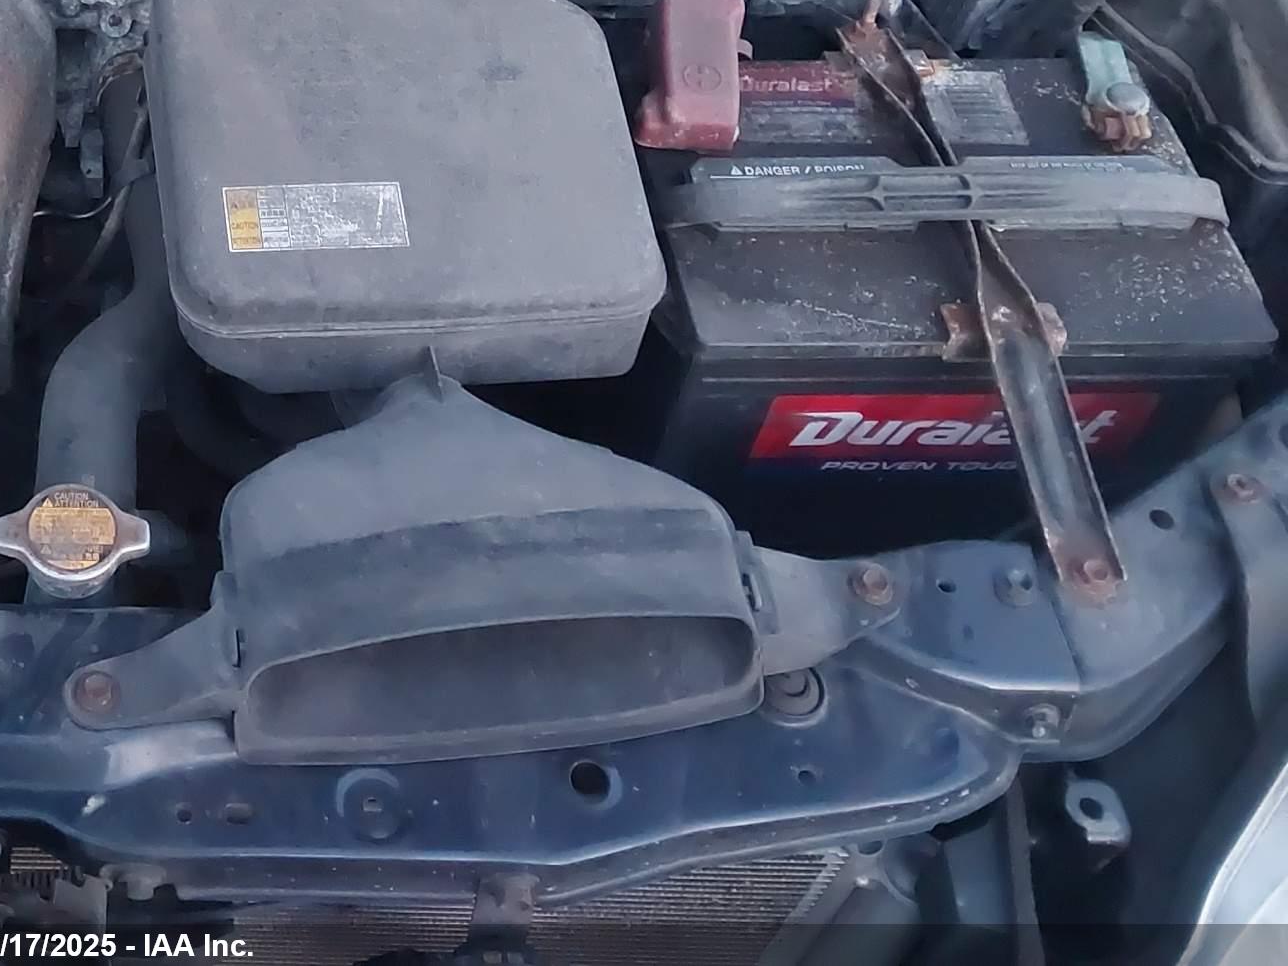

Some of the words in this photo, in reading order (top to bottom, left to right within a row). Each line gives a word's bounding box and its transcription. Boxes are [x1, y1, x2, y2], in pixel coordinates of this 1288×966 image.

[744, 165, 801, 176] DANGER
[789, 410, 1117, 446] Duralat
[820, 461, 937, 471] PROVEN
[947, 460, 1018, 471] TOUG
[53, 492, 89, 500] CAUTION
